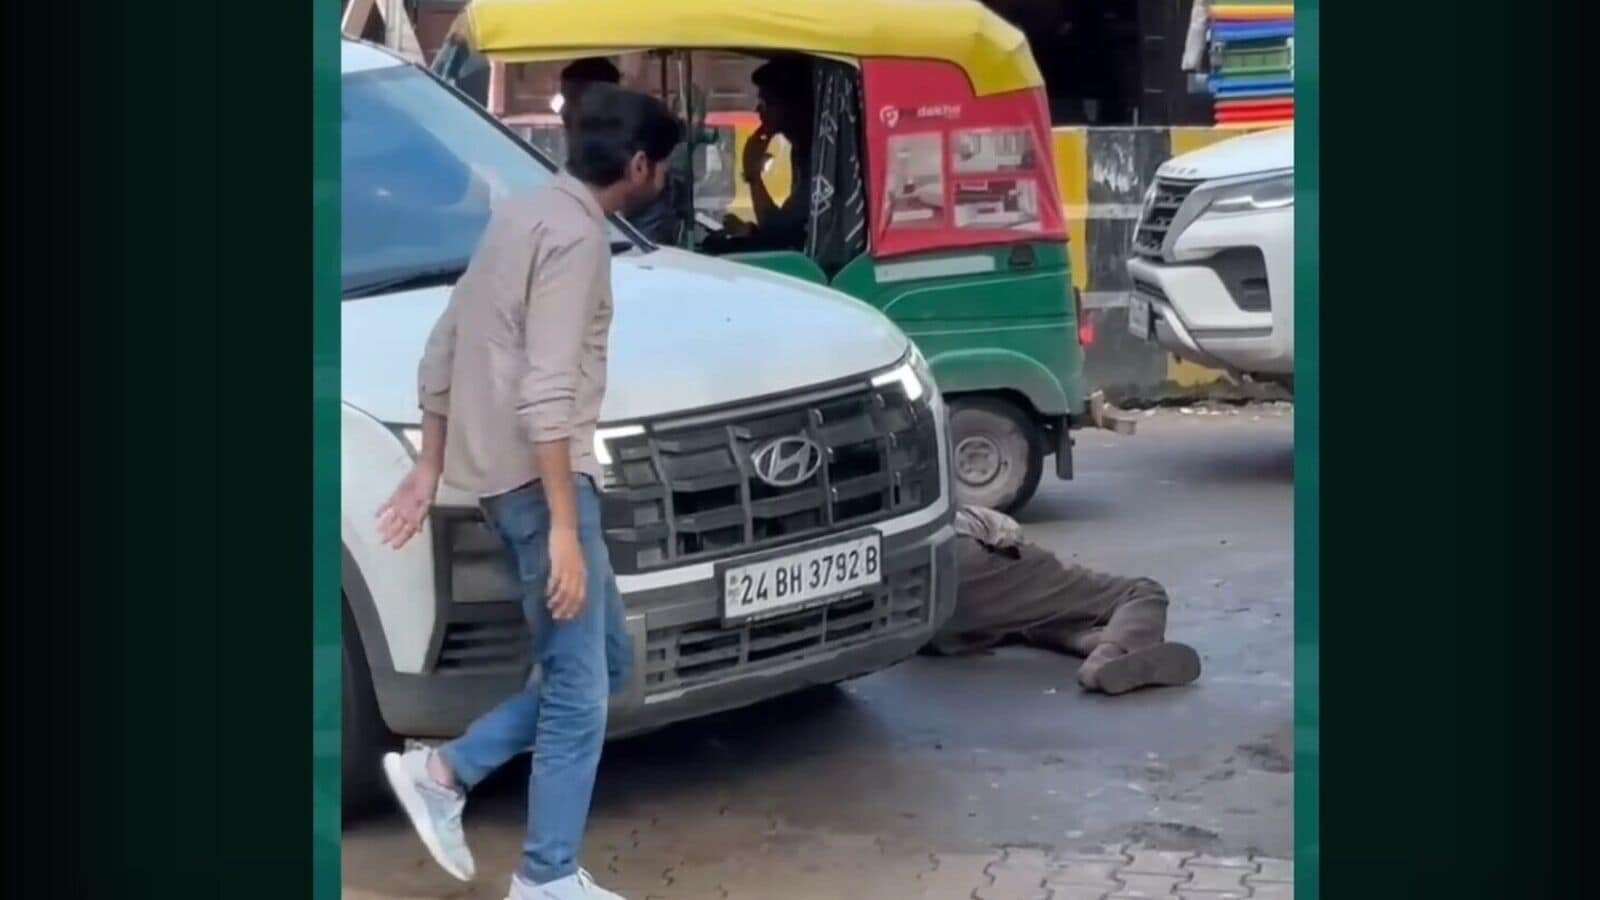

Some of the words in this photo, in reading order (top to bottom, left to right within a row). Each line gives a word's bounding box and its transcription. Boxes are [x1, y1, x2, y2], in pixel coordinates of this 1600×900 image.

[740, 571, 768, 606] 24
[775, 564, 802, 597] BH
[809, 550, 860, 589] 3792
[865, 546, 878, 575] B
